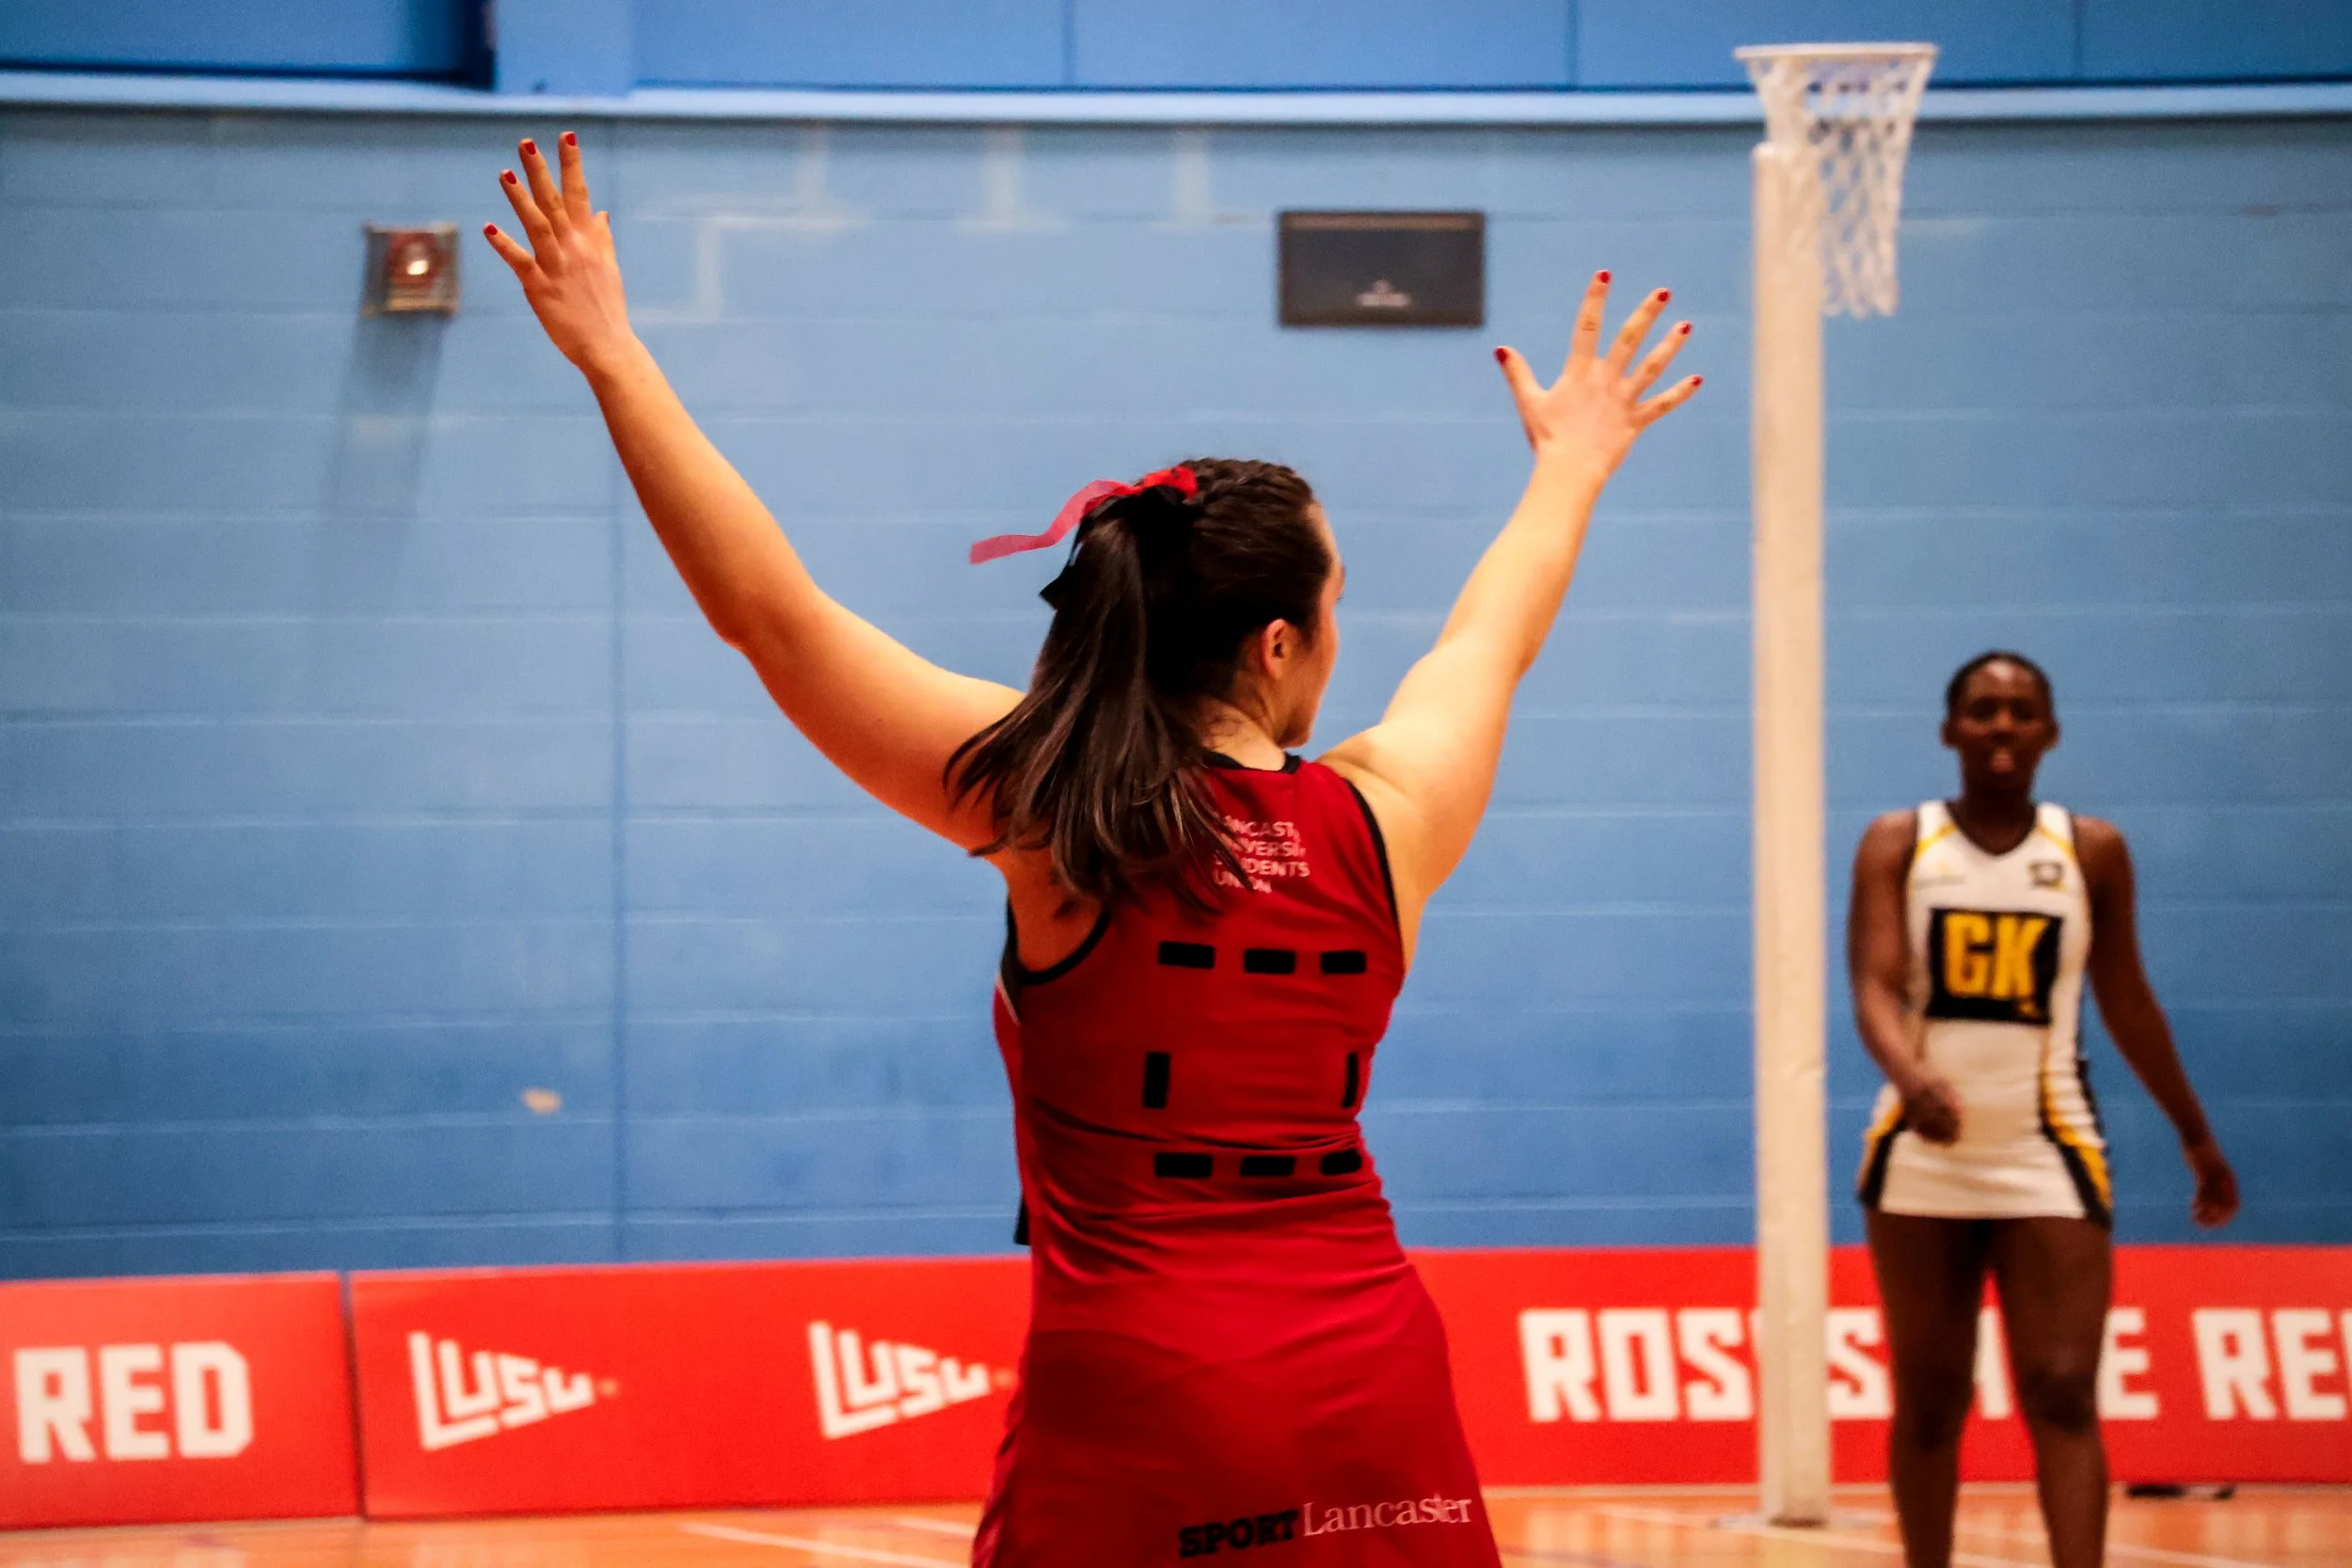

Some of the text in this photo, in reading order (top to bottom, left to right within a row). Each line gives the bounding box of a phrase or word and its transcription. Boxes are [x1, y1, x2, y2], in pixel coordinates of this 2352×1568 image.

[1944, 912, 2049, 999] GK
[14, 1341, 253, 1464] RED
[407, 1330, 597, 1451] LUSU
[808, 1321, 991, 1439] LUSU
[1518, 1307, 1894, 1422] ROSS
[2192, 1307, 2352, 1421] RE
[1178, 1493, 1473, 1559] SPORT Lancaster
